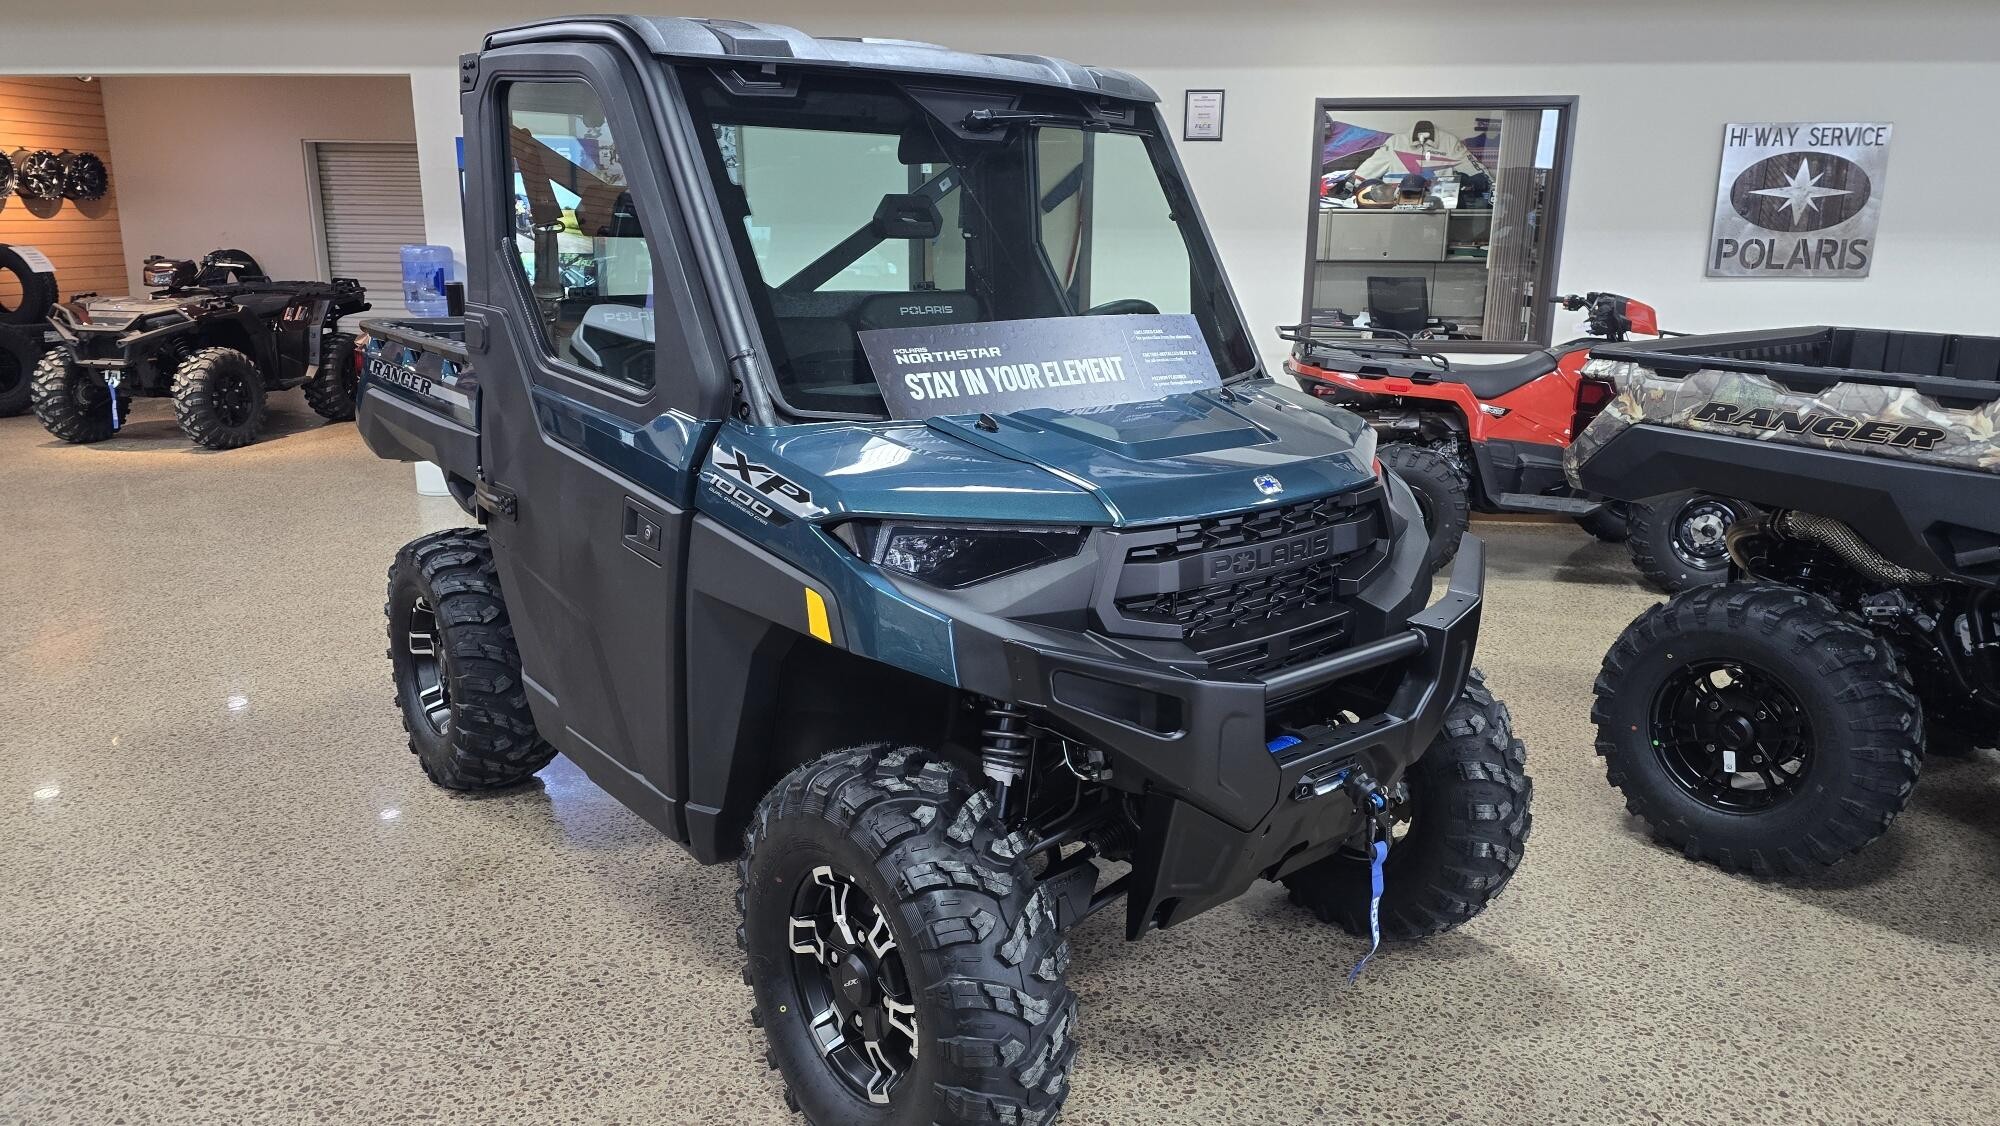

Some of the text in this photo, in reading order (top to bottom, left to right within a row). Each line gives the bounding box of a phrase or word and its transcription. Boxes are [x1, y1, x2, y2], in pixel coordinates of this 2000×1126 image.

[1729, 126, 1887, 147] HI-WAY SERVICE
[1714, 238, 1868, 270] POLARIS
[899, 305, 953, 316] POLARIS
[893, 347, 928, 355] POLARIS
[895, 346, 1002, 365] NORTHSTAR
[371, 359, 433, 397] RANGER
[904, 356, 1126, 401] STAY IN YOUR ELEMENT
[1694, 402, 1947, 450] RANGER
[712, 446, 812, 504] XP
[709, 473, 774, 518] 1000
[1210, 533, 1330, 579] POLARIS
